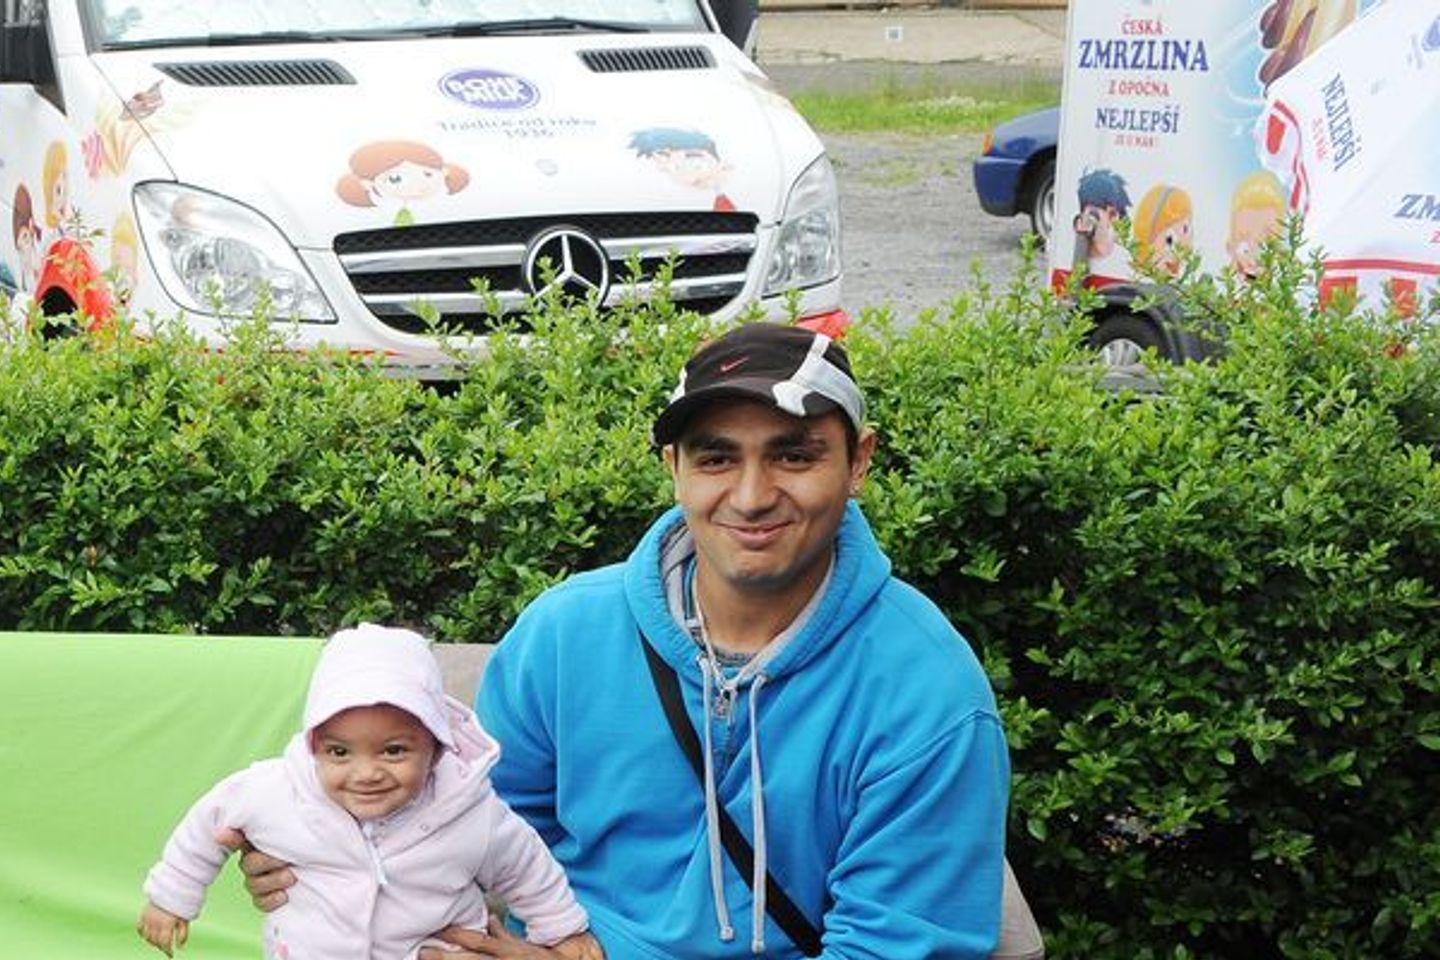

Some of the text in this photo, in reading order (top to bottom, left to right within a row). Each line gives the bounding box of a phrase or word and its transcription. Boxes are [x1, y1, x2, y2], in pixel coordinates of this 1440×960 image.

[1120, 13, 1164, 35] ČESKÁ
[1078, 39, 1210, 71] ZMRZLINA
[1094, 104, 1181, 134] NEJLEPŠÍ
[1320, 71, 1362, 172] NEJLEPŠÍ
